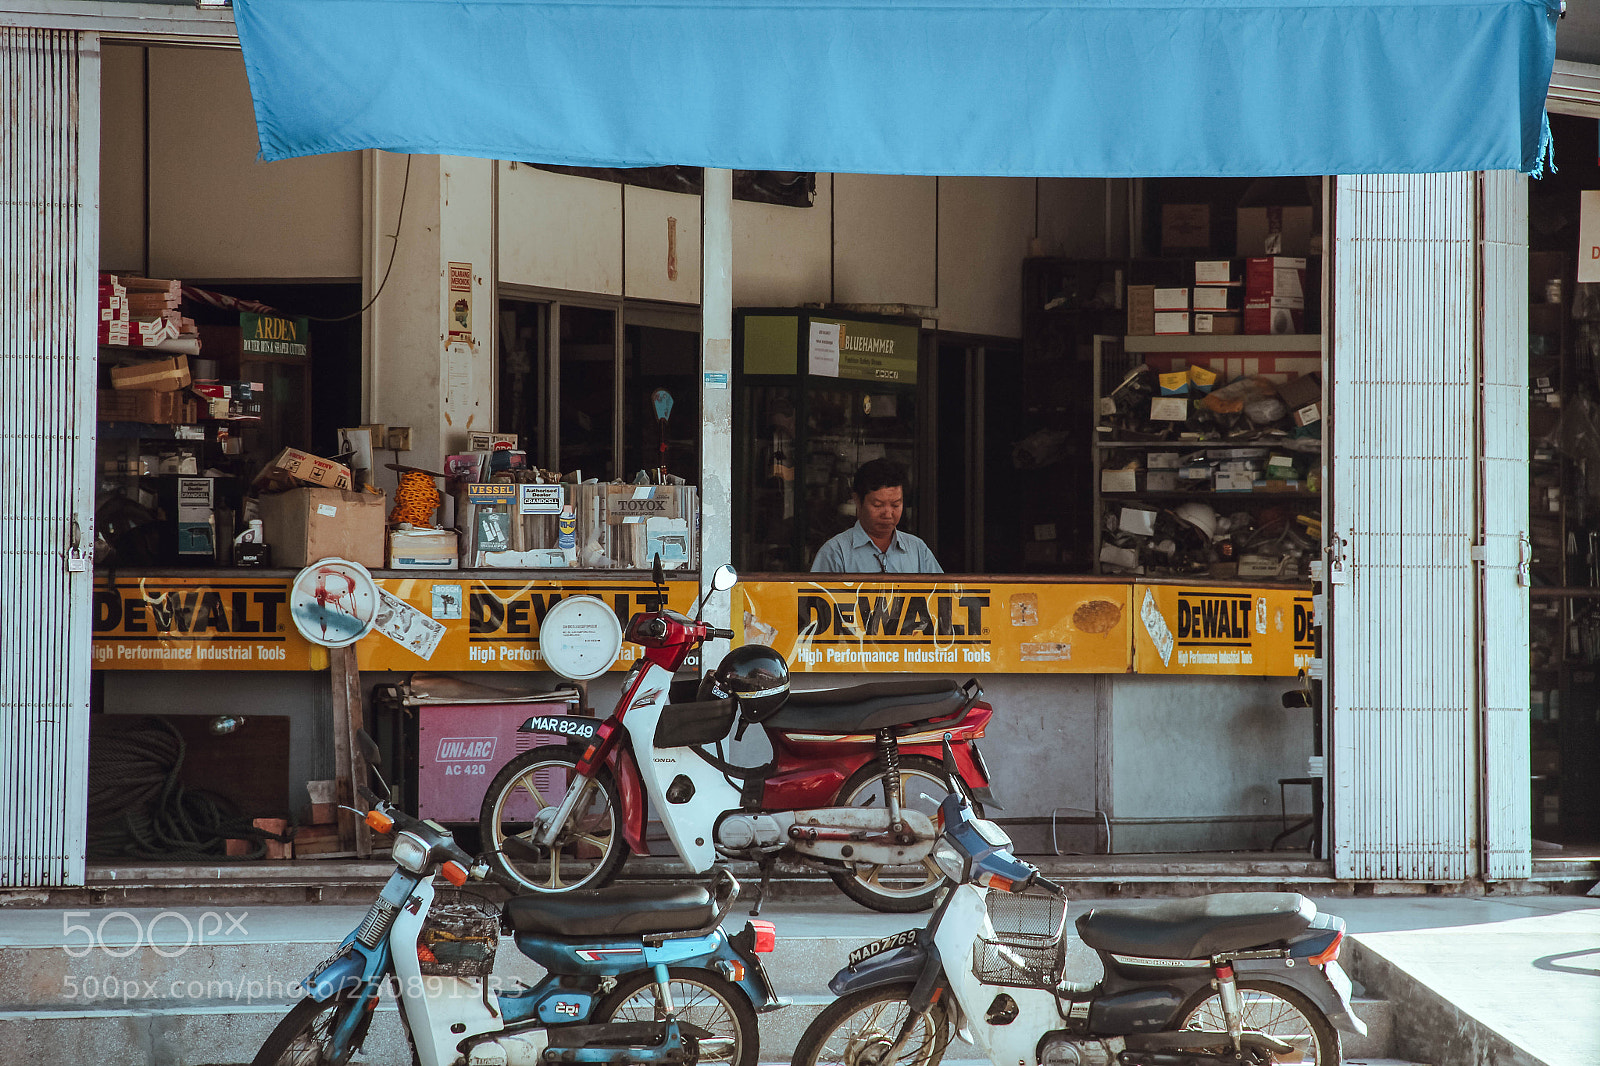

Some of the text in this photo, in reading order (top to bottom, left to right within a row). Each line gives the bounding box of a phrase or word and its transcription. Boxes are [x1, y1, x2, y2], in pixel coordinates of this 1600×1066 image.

[255, 316, 297, 341] ARDEN
[845, 335, 895, 354] BLUEHAMMER
[471, 486, 513, 494] VESSEL
[618, 500, 666, 511] TOYOX
[435, 585, 459, 593] BOSCH
[117, 645, 192, 660] Performance
[196, 645, 252, 660] Industrial
[257, 645, 286, 660] Tools
[469, 646, 496, 663] High
[797, 648, 991, 665] High Performance Industrial Tools
[1177, 650, 1253, 667] High Performance Industrial Tools
[531, 716, 594, 738] MAR 8249
[440, 741, 491, 758] UNI-ARC
[445, 765, 486, 775] AC 420
[850, 930, 916, 963] MAD 7769
